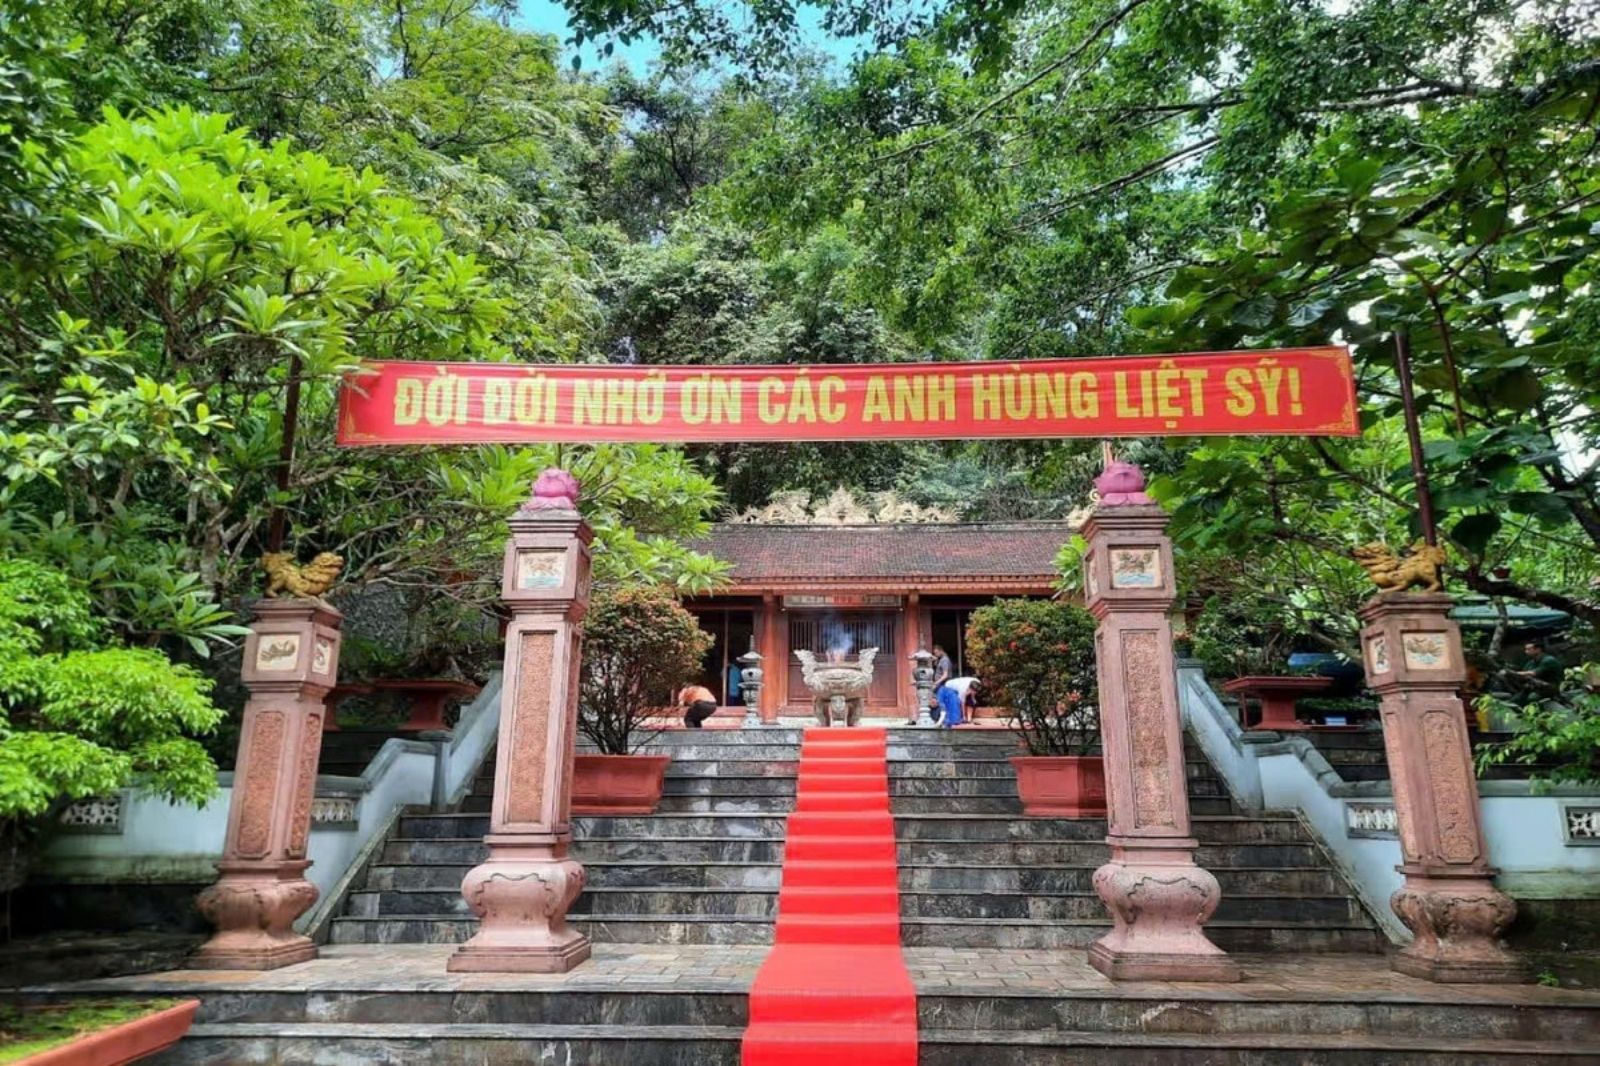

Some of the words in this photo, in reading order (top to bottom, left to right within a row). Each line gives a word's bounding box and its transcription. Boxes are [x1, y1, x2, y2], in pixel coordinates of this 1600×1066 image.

[573, 368, 667, 426] NHỚ
[679, 371, 743, 425] ƠN
[757, 368, 848, 425] CÁC
[861, 374, 957, 422] ANH
[971, 364, 1100, 421] HÙNG
[1114, 358, 1209, 429] LIỆT
[1224, 357, 1304, 417] SỸ!
